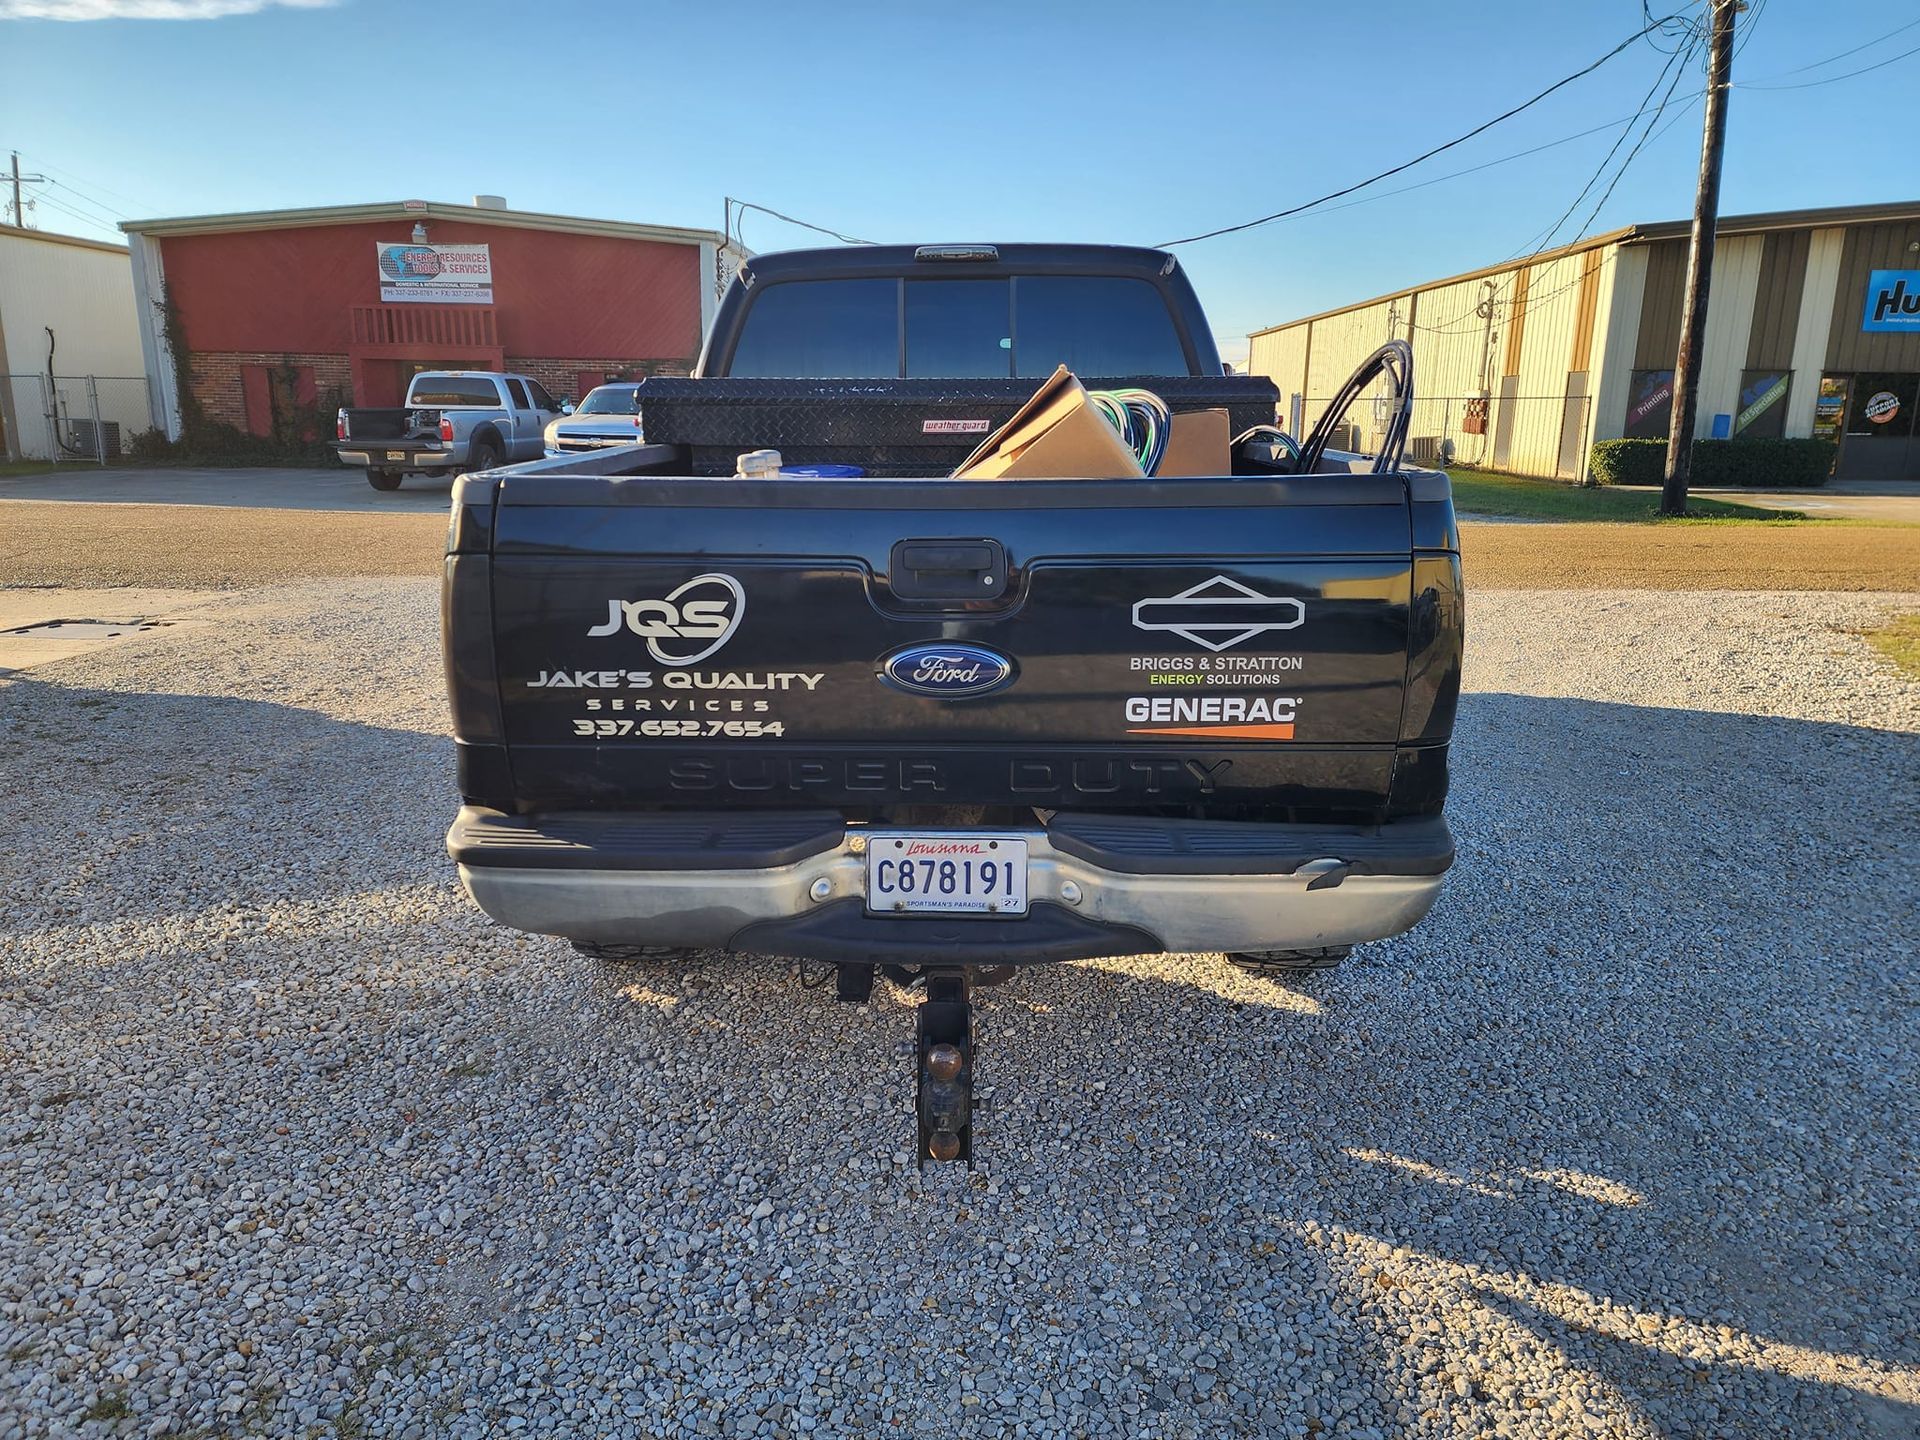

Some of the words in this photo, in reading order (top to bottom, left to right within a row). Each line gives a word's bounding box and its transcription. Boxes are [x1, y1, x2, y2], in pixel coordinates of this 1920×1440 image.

[405, 252, 438, 262] ENERGY
[440, 253, 487, 263] RESOURCES
[413, 264, 440, 273] TOOLS
[441, 265, 447, 273] &
[450, 265, 488, 273] SERVICES
[1637, 389, 1669, 416] Printing
[925, 421, 960, 429] weather
[962, 421, 987, 430] guard
[586, 599, 731, 638] JQS
[913, 655, 981, 682] Ford
[1130, 657, 1194, 670] BRIGGS
[1198, 657, 1210, 670] &
[1215, 657, 1303, 670] STRATTON
[526, 669, 653, 689] JAKE'S
[662, 671, 825, 690] QUALITY
[1150, 675, 1204, 685] ENERGY
[1206, 674, 1281, 685] SOLUTIONS
[586, 698, 769, 712] SERVICES
[1125, 697, 1296, 722] GENERAC
[572, 719, 785, 738] 337.652.7654
[668, 757, 947, 792] SUPER
[1008, 758, 1234, 794] DUTY
[906, 840, 988, 856] Louisiana
[878, 859, 1012, 895] C878191
[906, 900, 953, 908] SPORTSMAN'S
